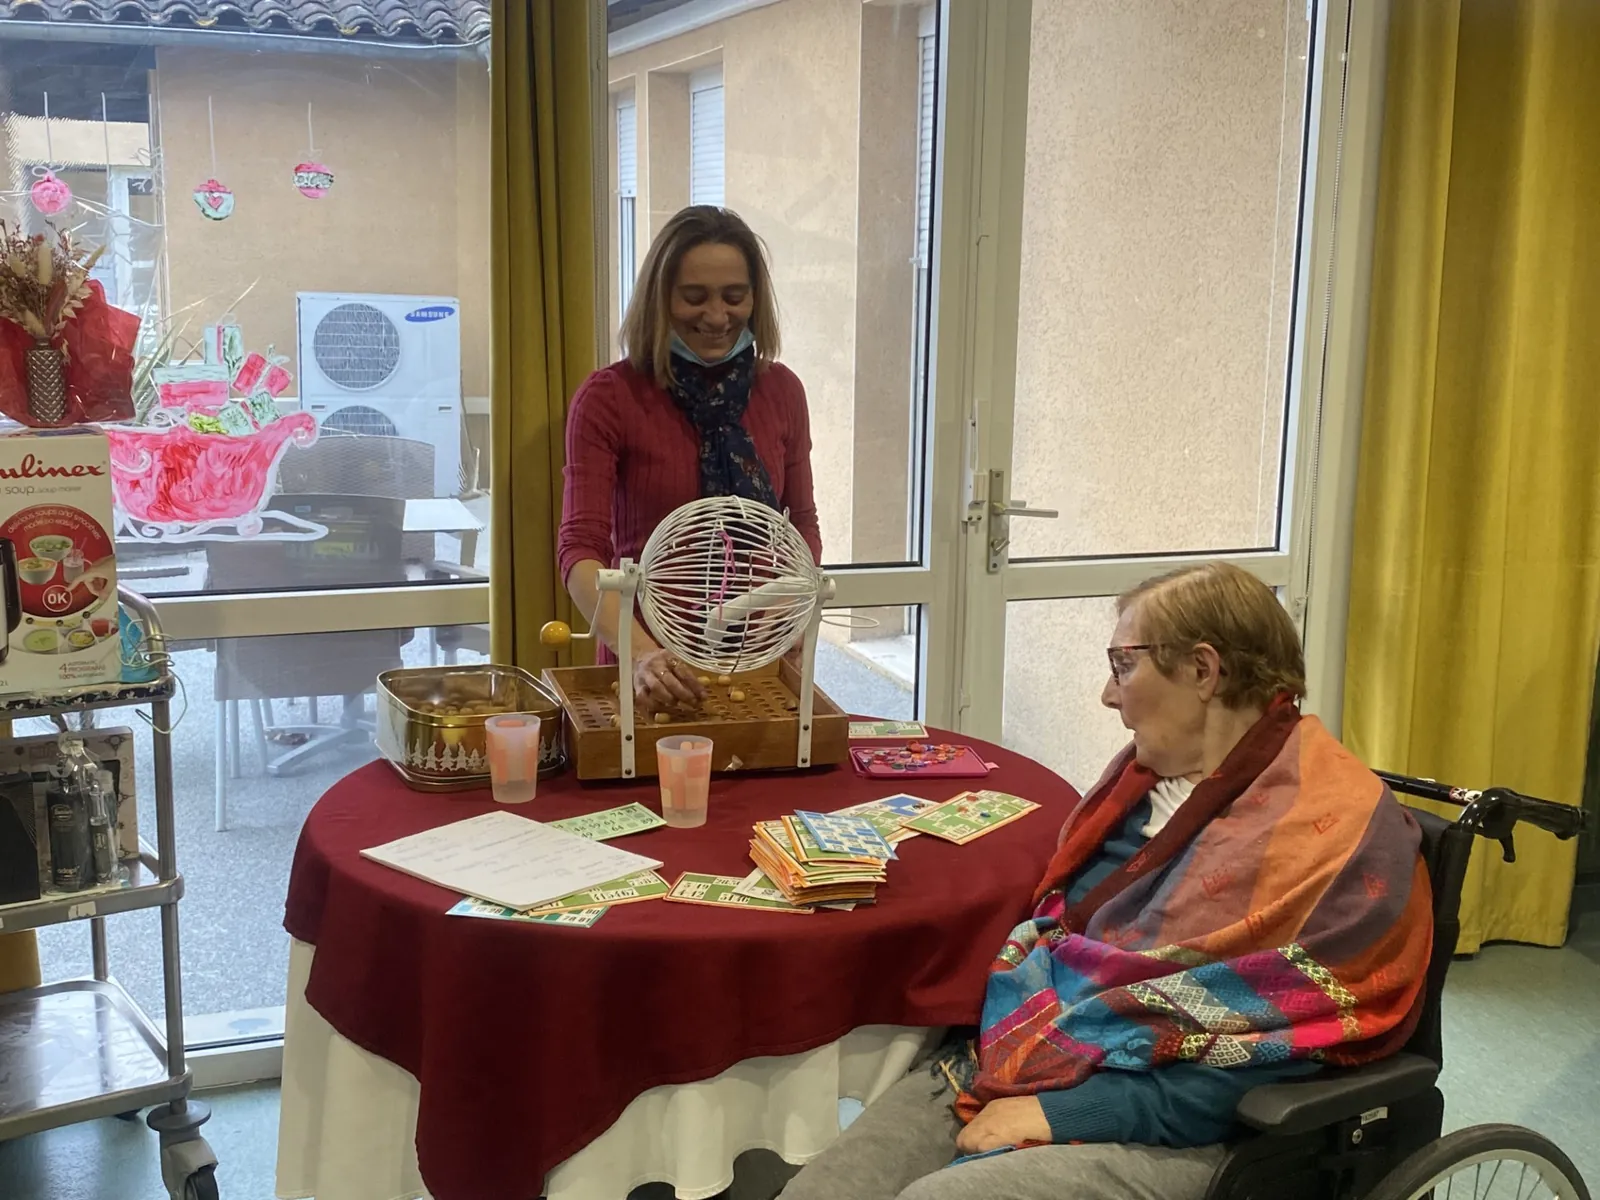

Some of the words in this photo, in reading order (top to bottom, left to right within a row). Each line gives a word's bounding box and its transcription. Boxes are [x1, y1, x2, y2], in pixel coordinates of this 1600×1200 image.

[410, 311, 450, 319] SAMSUNG
[5, 486, 34, 496] soup
[47, 592, 68, 605] OK
[59, 662, 67, 673] 4
